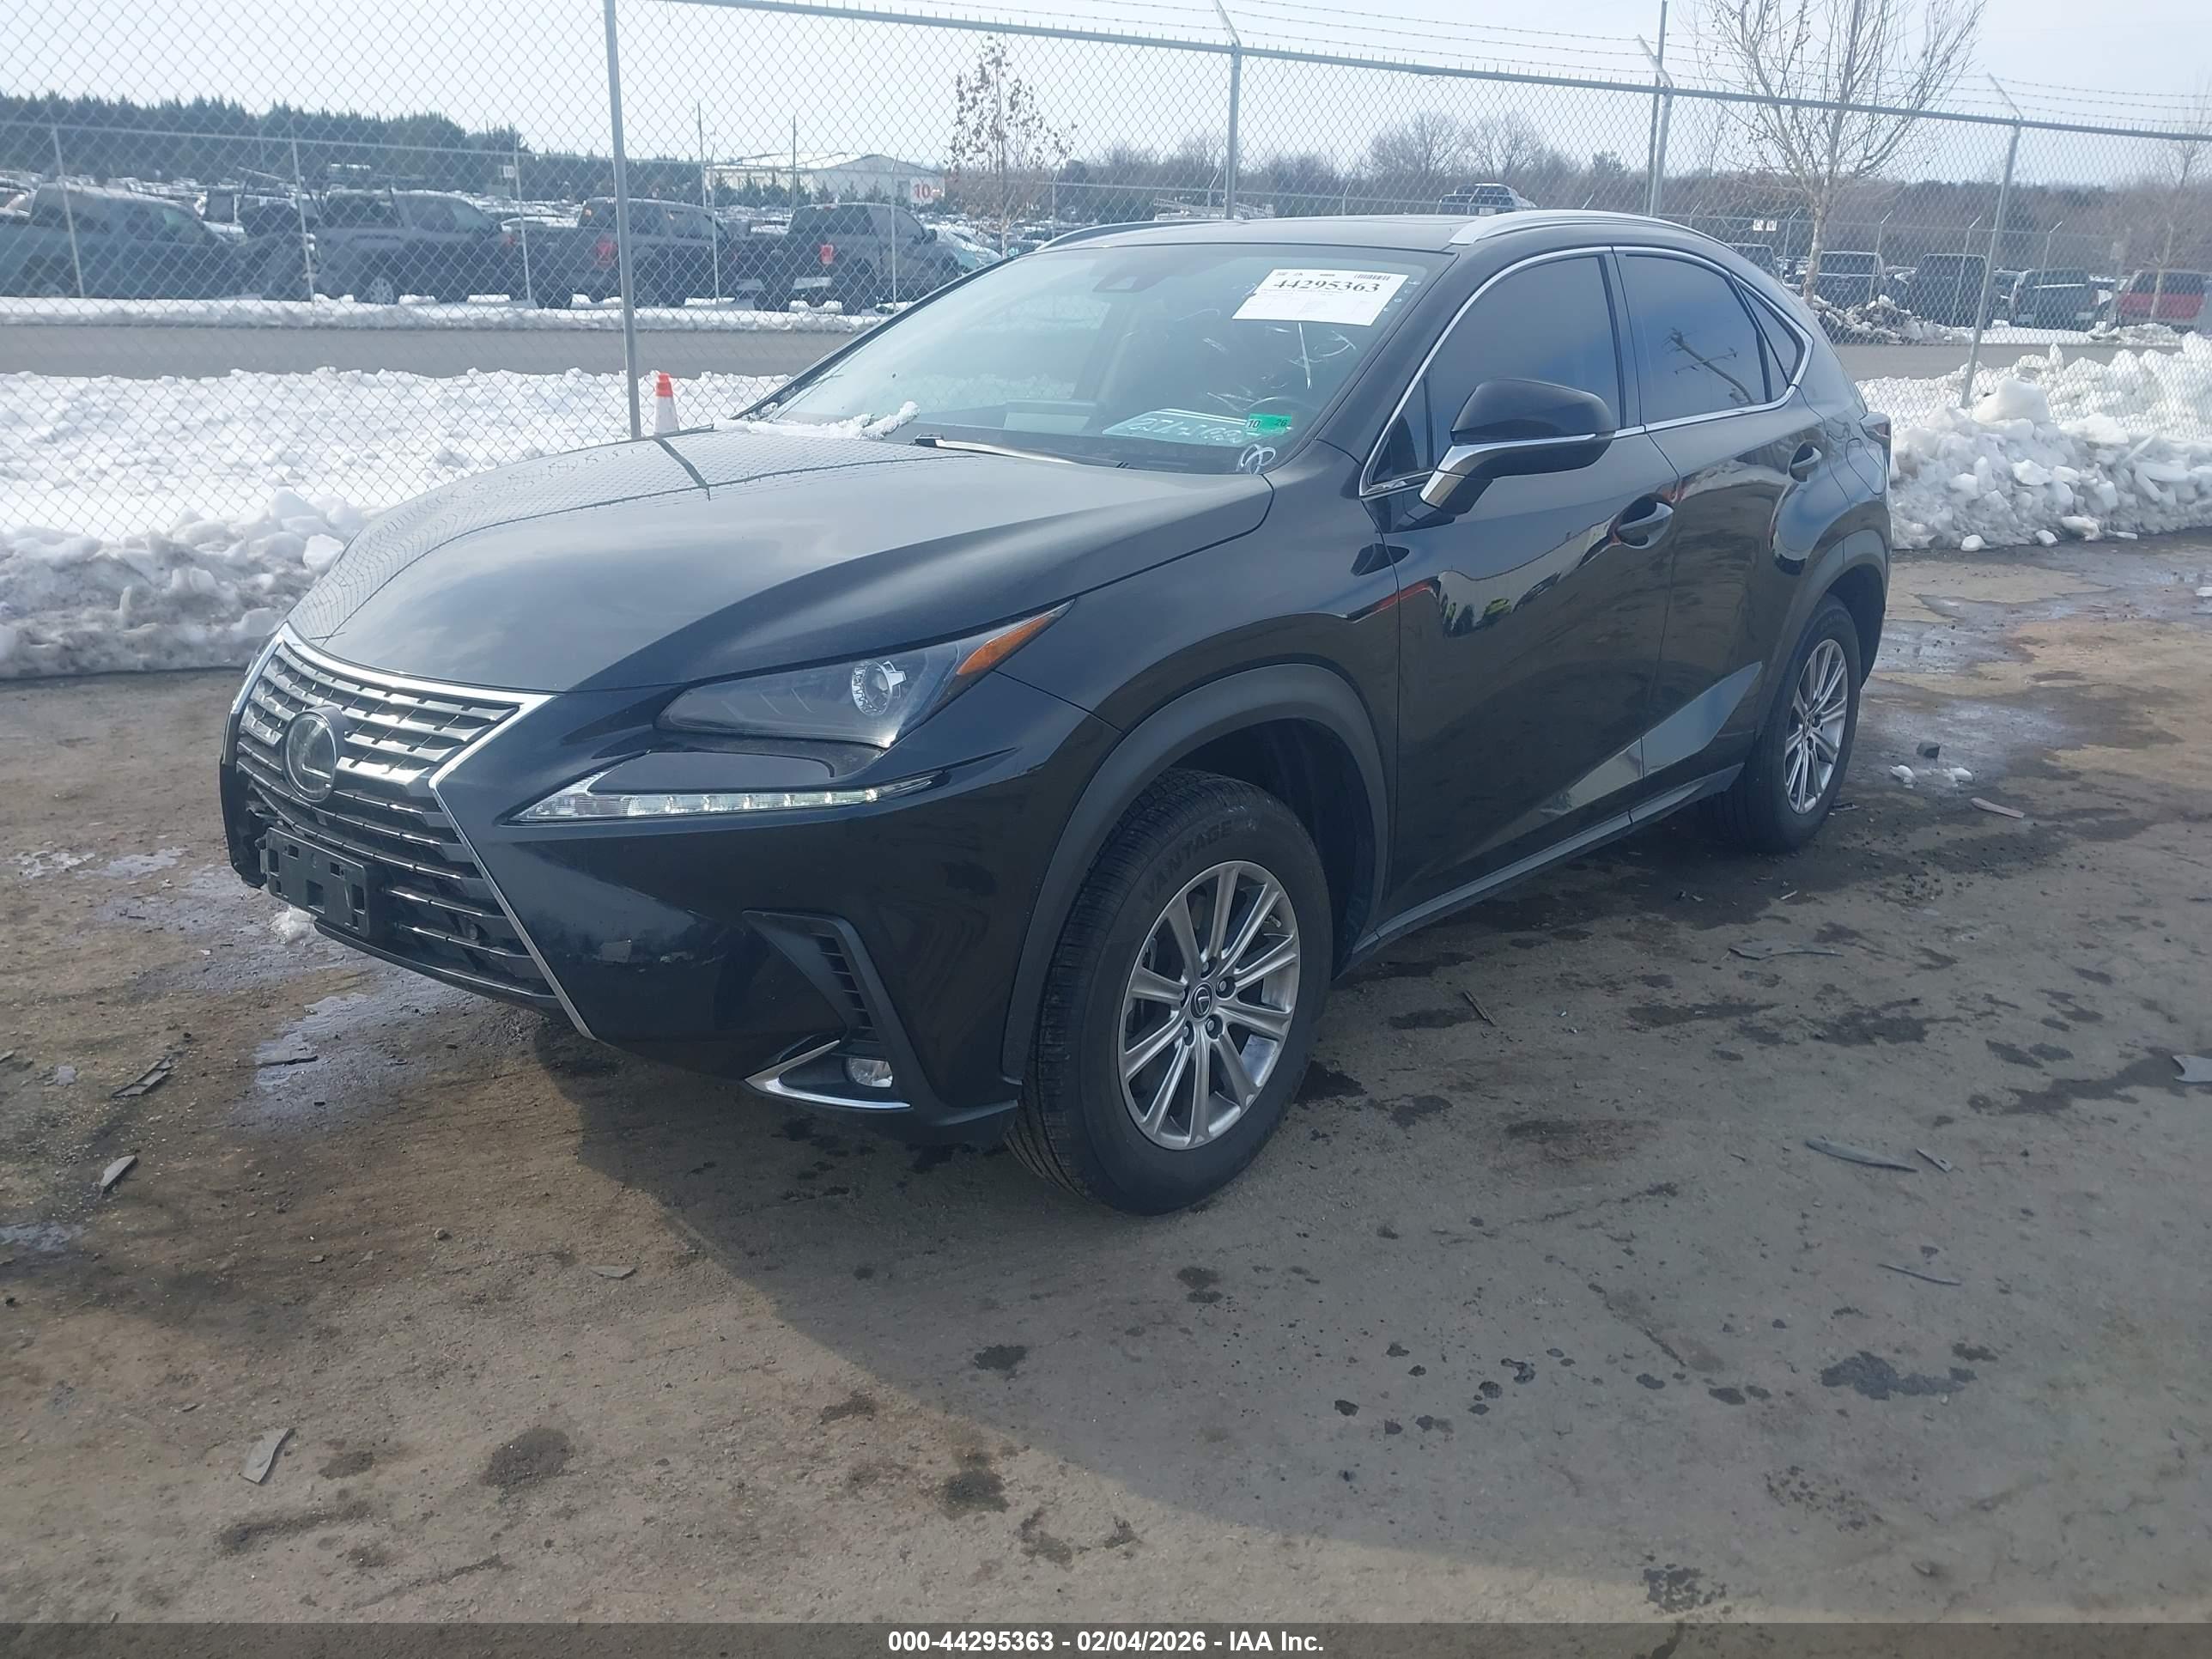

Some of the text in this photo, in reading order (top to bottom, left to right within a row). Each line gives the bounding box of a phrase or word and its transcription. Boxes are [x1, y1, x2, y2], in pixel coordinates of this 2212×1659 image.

[1273, 279, 1381, 293] 44295363
[1248, 419, 1261, 428] 10
[1141, 819, 1232, 901] VANTAGE
